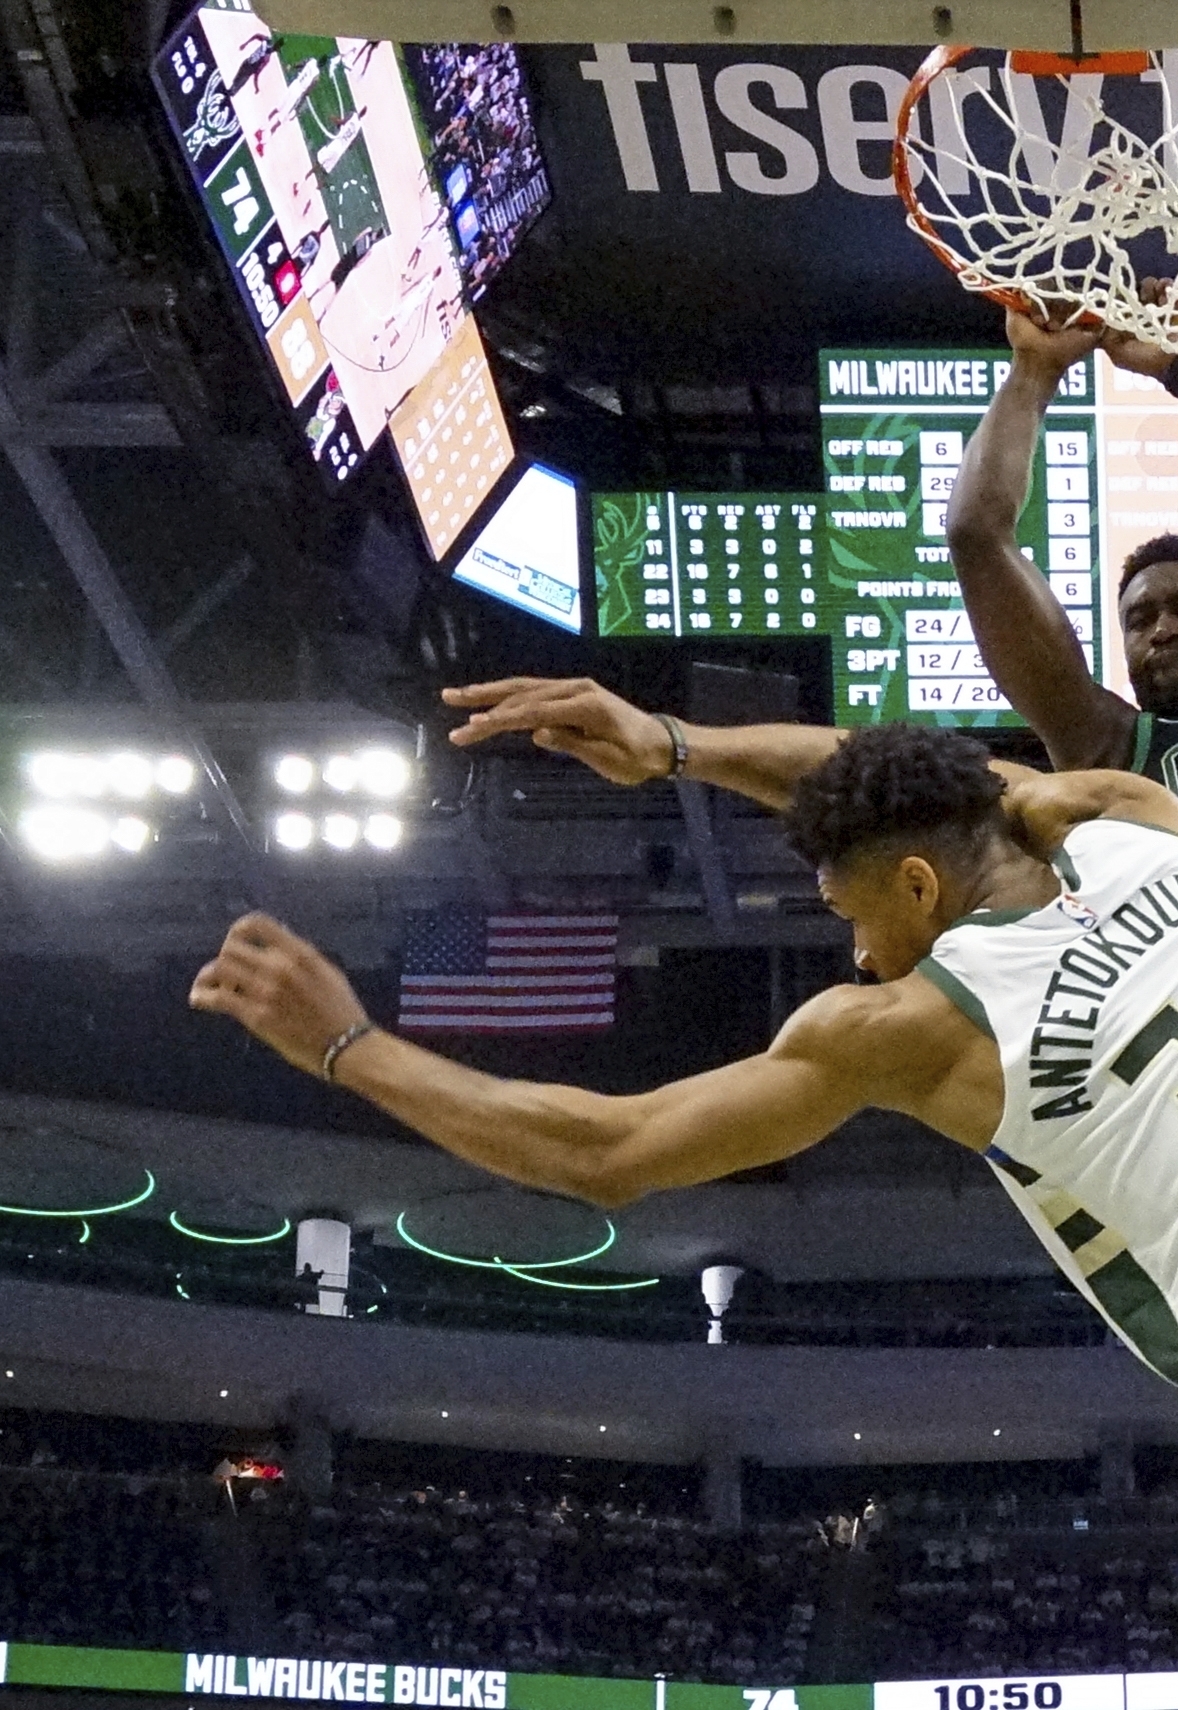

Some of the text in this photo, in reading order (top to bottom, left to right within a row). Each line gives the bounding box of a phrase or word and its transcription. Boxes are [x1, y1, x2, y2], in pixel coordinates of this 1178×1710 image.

[221, 167, 260, 235] 74
[242, 252, 279, 328] 10:50
[829, 360, 988, 396] MILWAUKEE
[936, 443, 947, 456] 6
[1057, 443, 1078, 456] 15
[1065, 477, 1072, 491] 1
[1064, 514, 1076, 528] 3
[646, 539, 813, 555] 11 3 3 0 2
[1064, 547, 1076, 560] 6
[643, 563, 669, 579] 22
[727, 563, 740, 579] 7
[802, 563, 812, 579] 1
[644, 588, 815, 604] 23 3 3 0 0
[1066, 583, 1078, 596] 6
[646, 613, 671, 629] 34
[729, 613, 743, 629] 7
[766, 613, 780, 629] 2
[802, 613, 816, 629] 0
[845, 615, 881, 638] FG
[915, 618, 943, 634] 24
[848, 650, 900, 672] 3PT
[919, 653, 942, 669] 12
[848, 684, 882, 706] FT
[919, 687, 943, 702] 14
[971, 686, 1000, 702] 20
[185, 1652, 507, 1710] MILWAUKEE BUCKS
[934, 1682, 1063, 1710] 10:50
